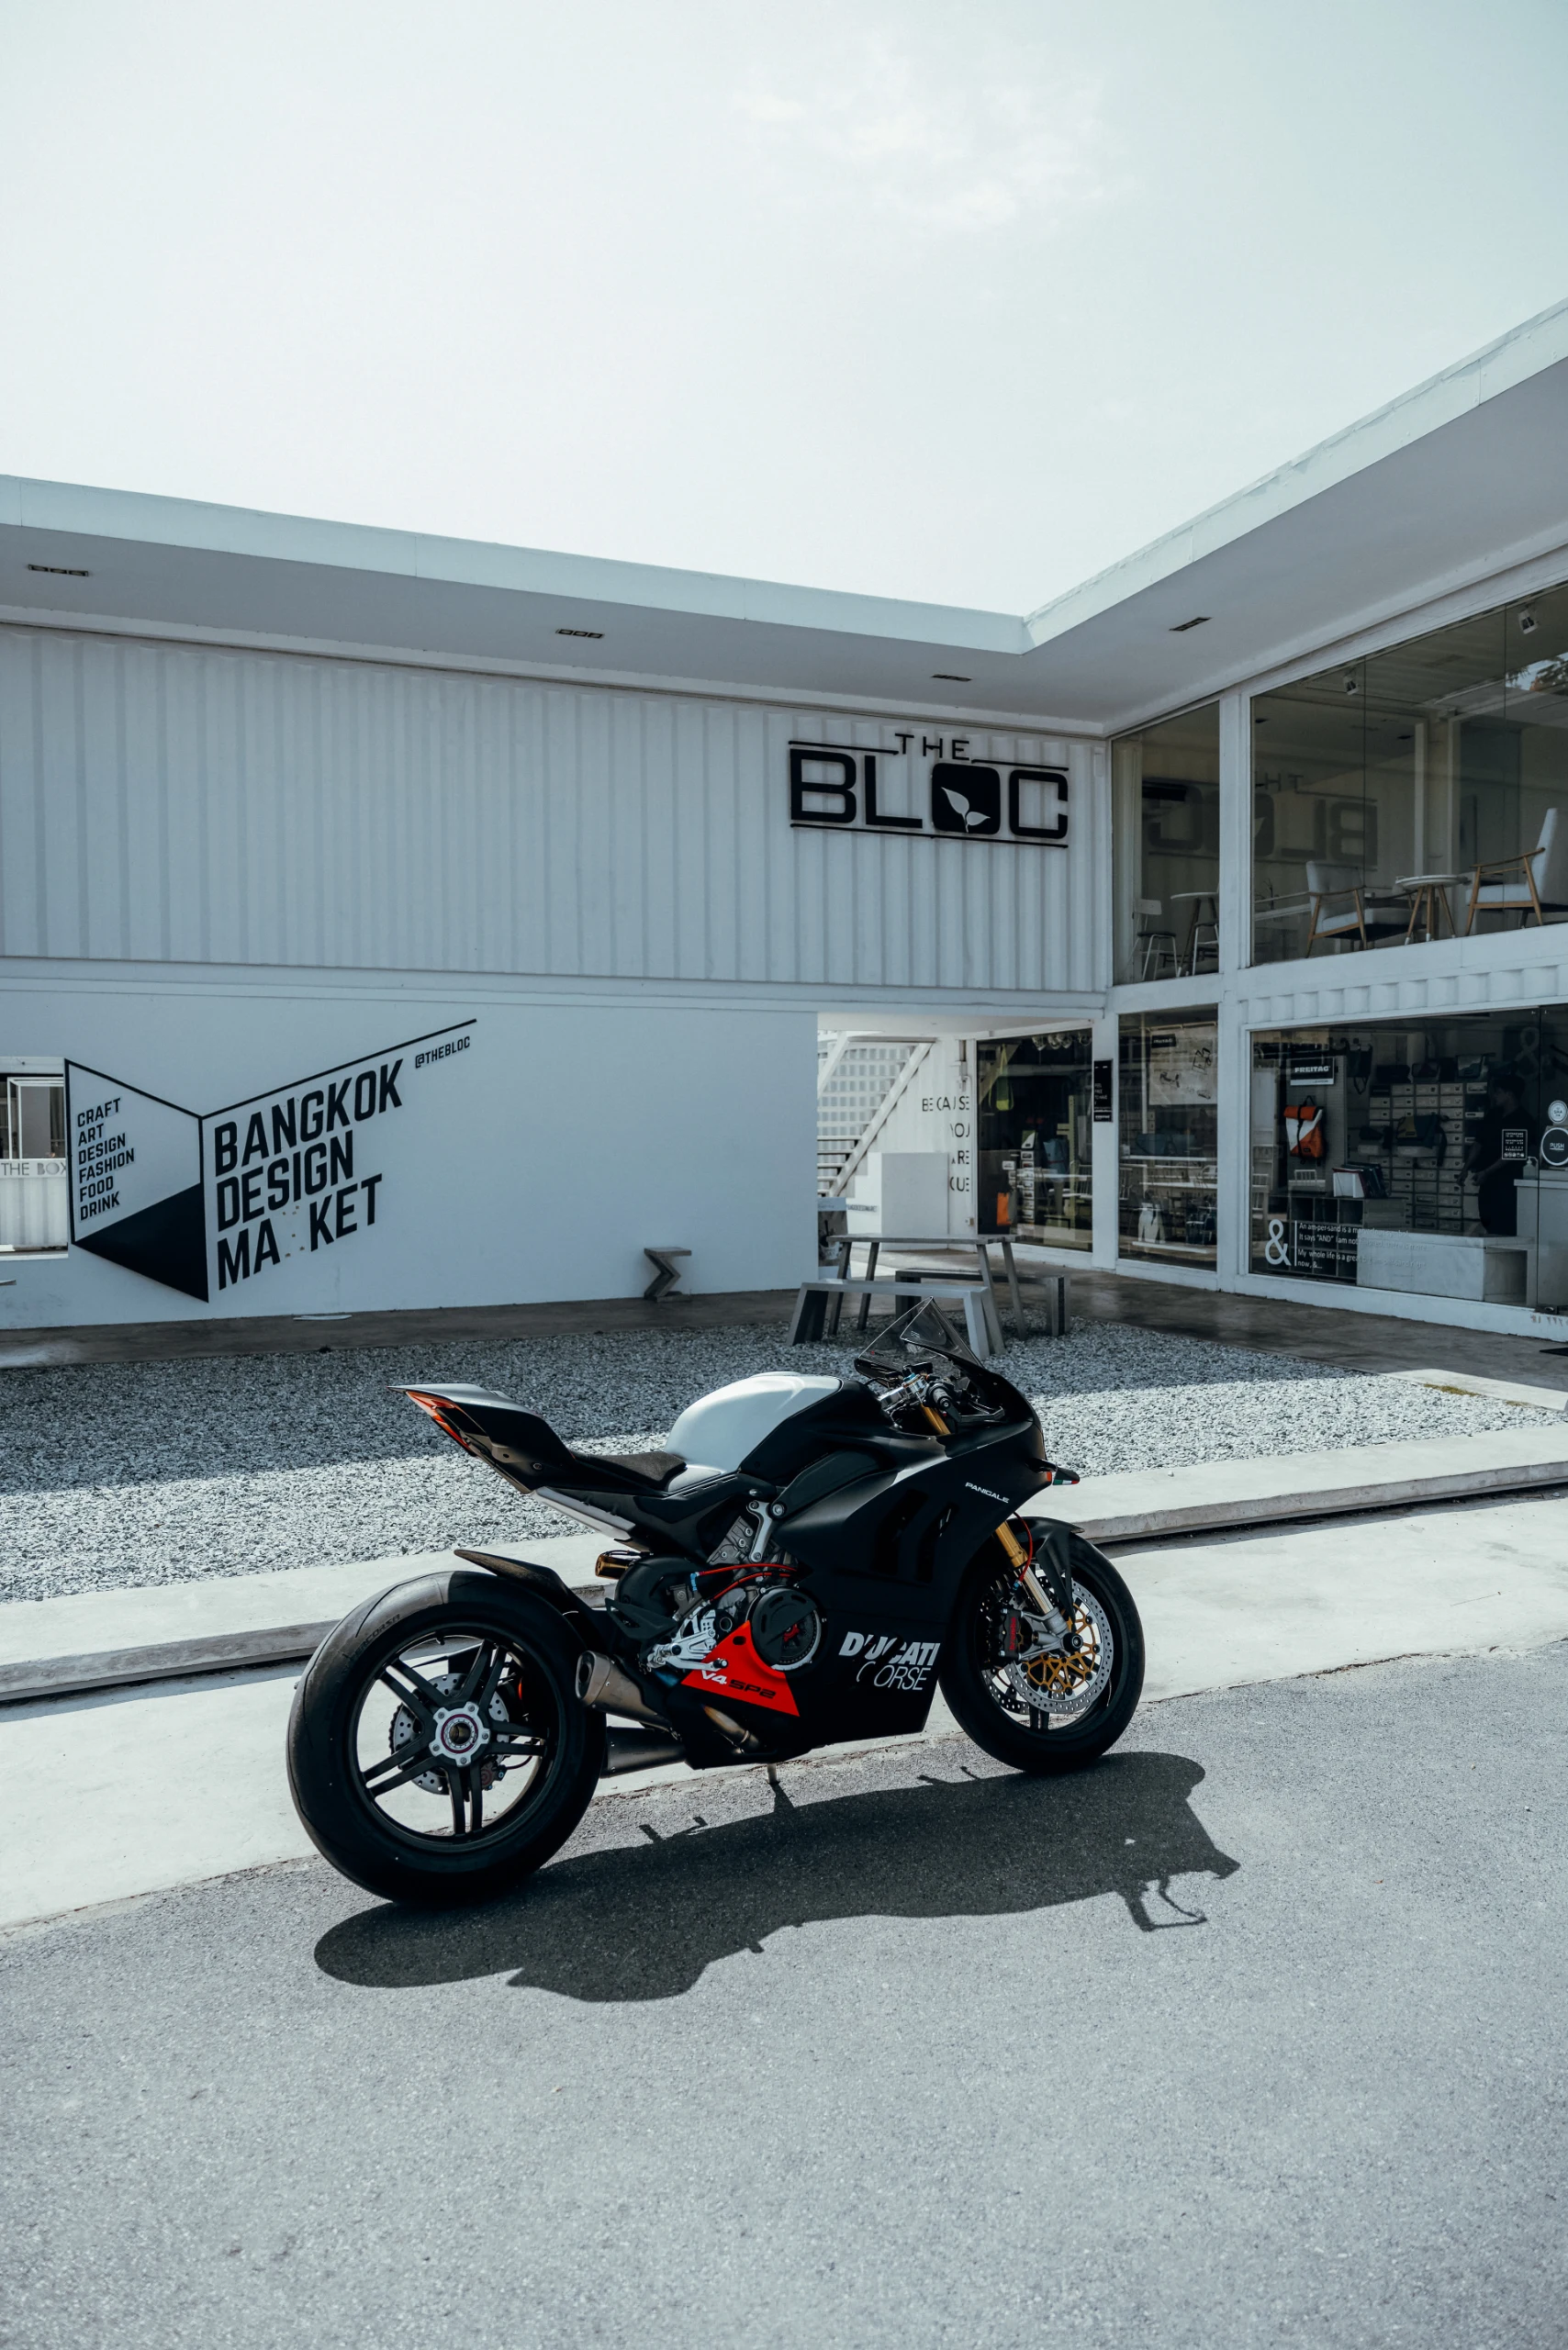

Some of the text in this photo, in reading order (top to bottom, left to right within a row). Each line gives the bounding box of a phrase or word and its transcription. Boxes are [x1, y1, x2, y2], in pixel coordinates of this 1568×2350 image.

[895, 733, 969, 761] THE
[415, 1035, 471, 1069] @THEBLOC
[1294, 1065, 1330, 1073] FREITAG
[77, 1097, 121, 1128] CRAFT
[214, 1058, 403, 1177] BANGKOK
[77, 1123, 105, 1147] ART
[78, 1132, 127, 1165] DESIGN
[1, 1162, 29, 1176] THE
[78, 1147, 135, 1184] FASHION
[951, 1150, 970, 1165] RE
[79, 1175, 115, 1203] FOOD
[216, 1130, 354, 1232] DESIGN
[79, 1192, 120, 1221] DRINK
[217, 1173, 383, 1291] MAKET
[1298, 1248, 1306, 1257] My
[1308, 1250, 1325, 1259] whole
[1326, 1251, 1335, 1259] life
[965, 1482, 1010, 1504] PANIGALE
[838, 1630, 941, 1666] DUCATI
[701, 1669, 777, 1699] V4 SP2
[856, 1660, 932, 1691] CORSE
